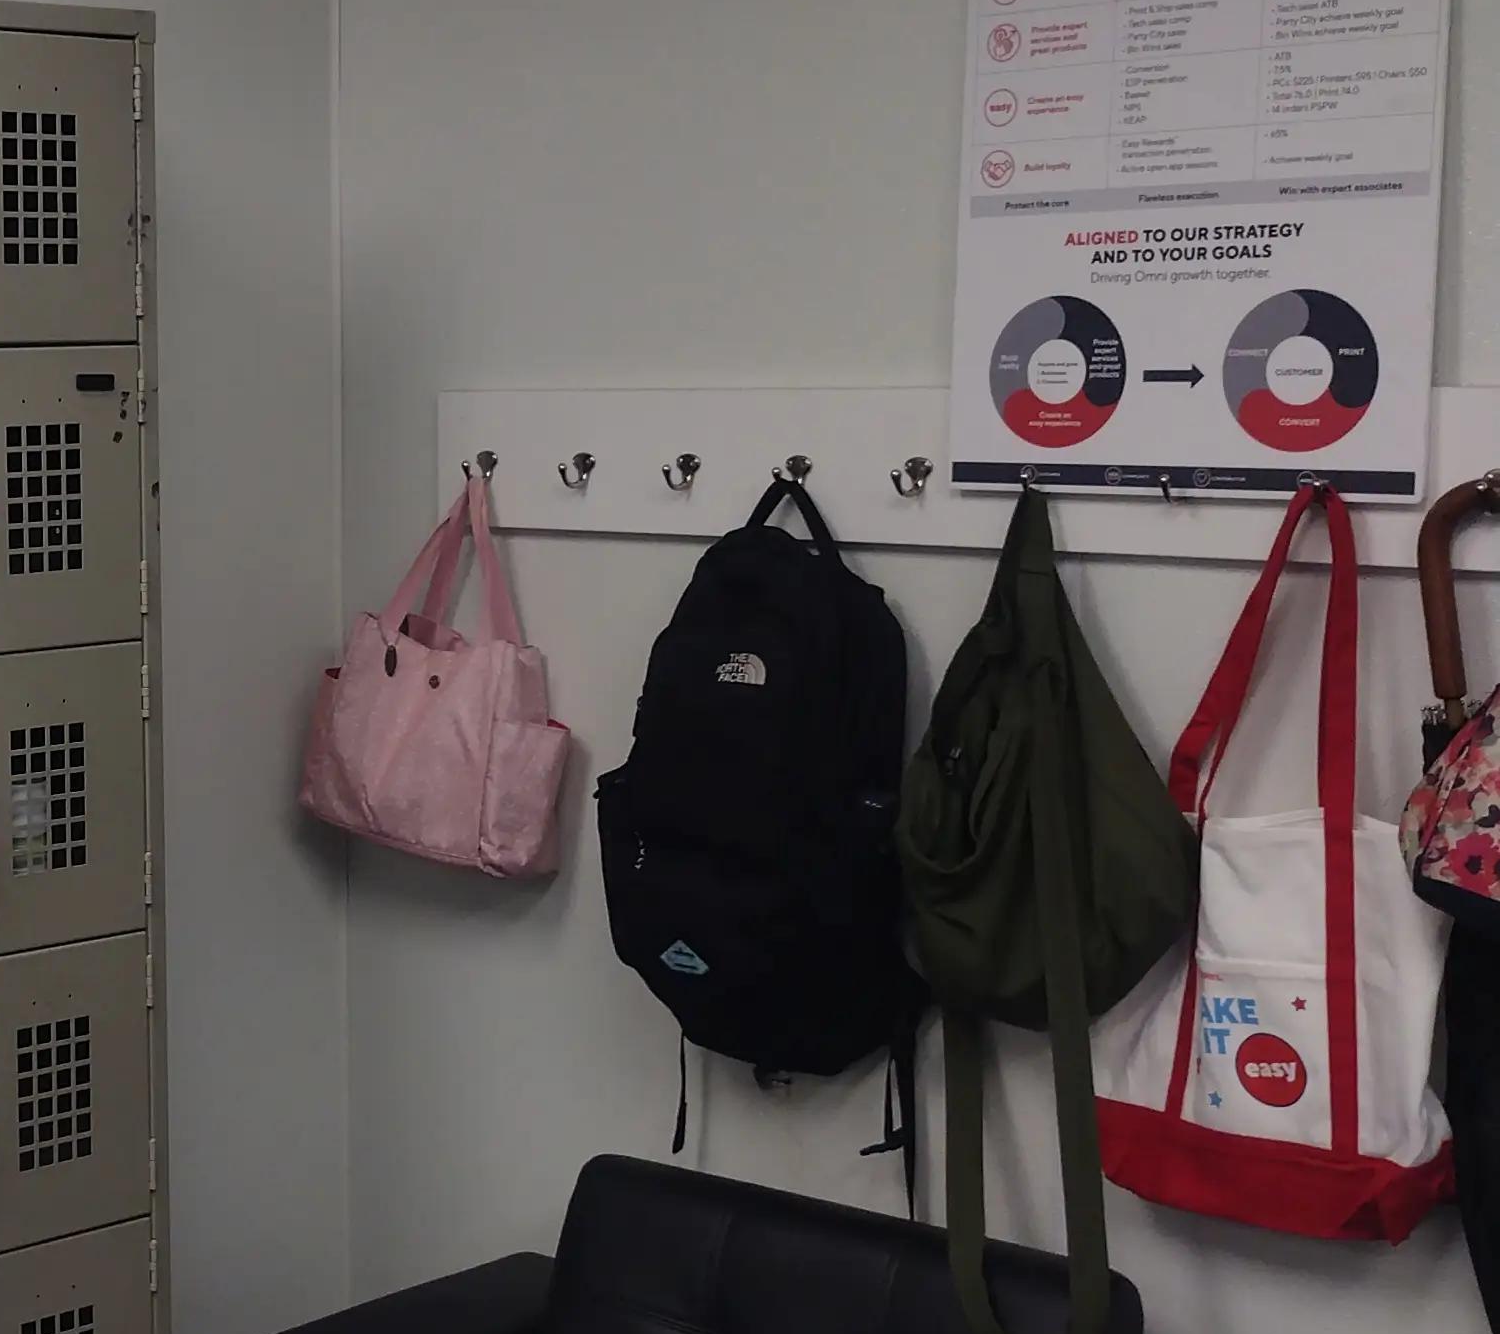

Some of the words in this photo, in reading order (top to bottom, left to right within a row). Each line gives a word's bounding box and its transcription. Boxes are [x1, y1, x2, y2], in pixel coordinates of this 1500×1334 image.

[989, 103, 1012, 114] easy
[1279, 186, 1297, 195] Win
[1300, 185, 1319, 195] with
[1321, 184, 1352, 195] expert
[1354, 182, 1403, 192] associates
[1138, 194, 1175, 203] Flawless
[1176, 192, 1220, 201] execution
[1005, 201, 1035, 211] Protect
[1036, 200, 1050, 209] the
[1051, 200, 1070, 208] core
[1064, 230, 1139, 246] ALIGNED
[1143, 228, 1166, 243] TO
[1171, 227, 1209, 242] OUR
[1213, 223, 1304, 240] STRATEGY
[1091, 249, 1127, 265] AND
[1132, 248, 1155, 263] TO
[1160, 246, 1207, 262] YOUR
[1212, 244, 1272, 260] GOALS
[1091, 270, 1131, 285] Driving
[1135, 270, 1167, 283] Omni
[1171, 268, 1212, 285] growth
[1216, 266, 1270, 283] together.
[1338, 347, 1365, 356] PRINT
[1275, 368, 1323, 376] CUSTOMER
[1278, 418, 1321, 427] CONVERT
[730, 653, 748, 663] THE
[718, 672, 746, 683] FACE
[1201, 996, 1259, 1025] AKE
[1203, 1028, 1230, 1054] IT
[1244, 1062, 1297, 1083] easy
